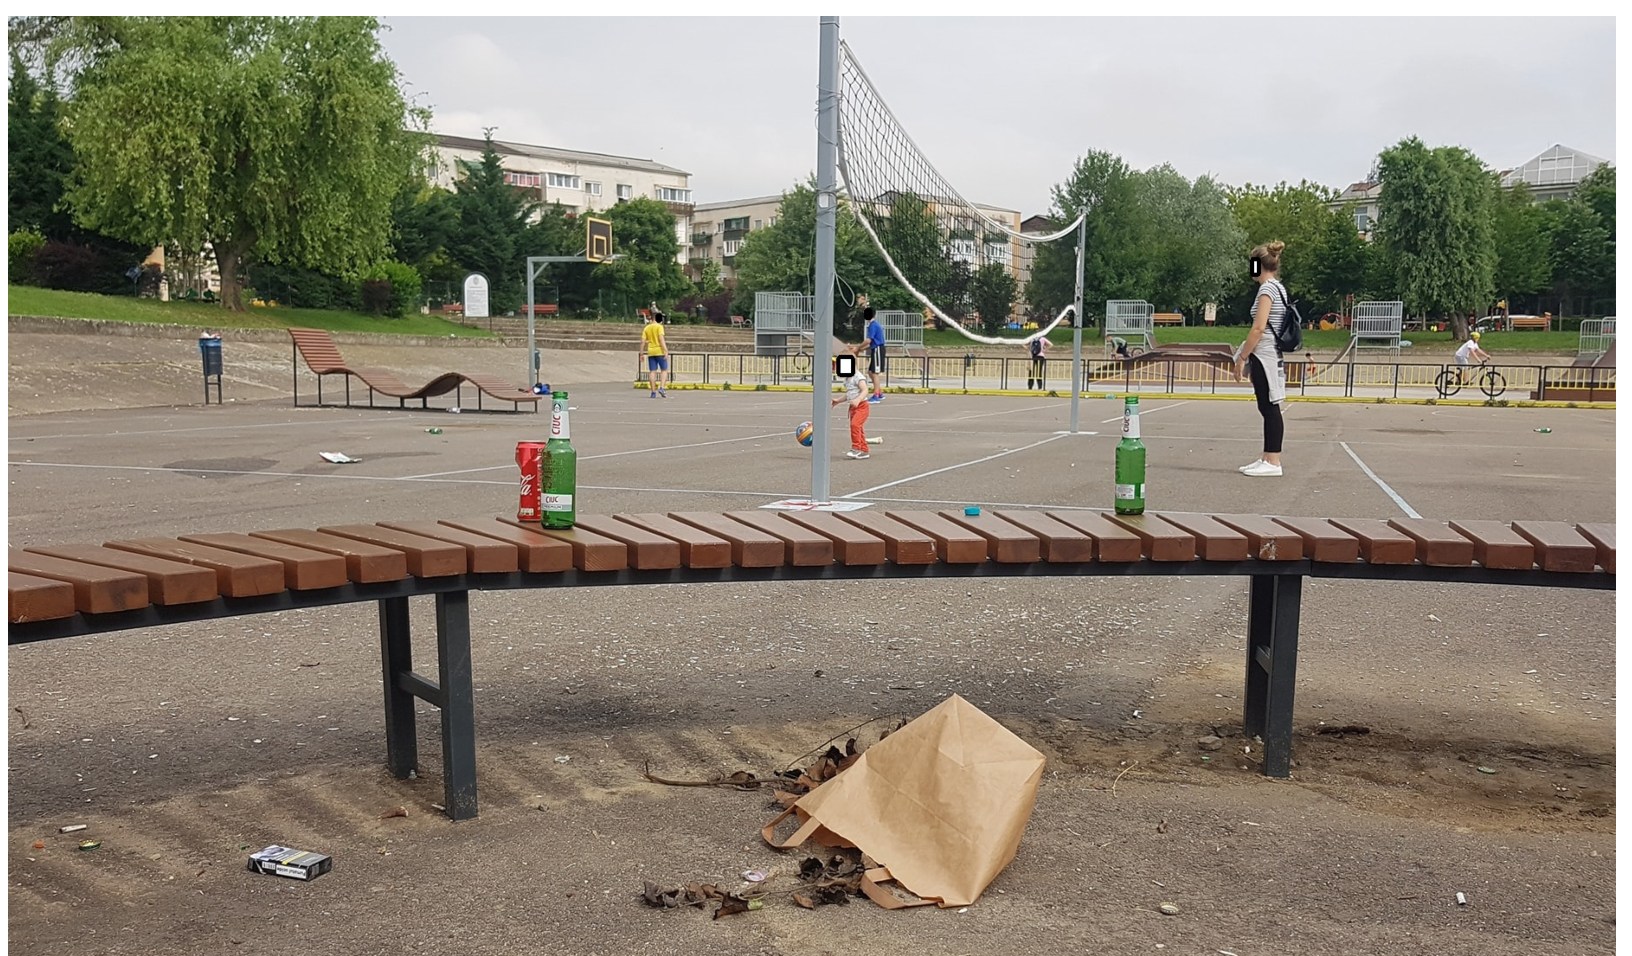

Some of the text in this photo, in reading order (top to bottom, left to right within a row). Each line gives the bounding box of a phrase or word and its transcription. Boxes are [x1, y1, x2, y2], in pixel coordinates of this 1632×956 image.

[551, 415, 561, 435] CIUC
[1123, 417, 1131, 433] CIUC
[545, 496, 559, 504] CIUC
